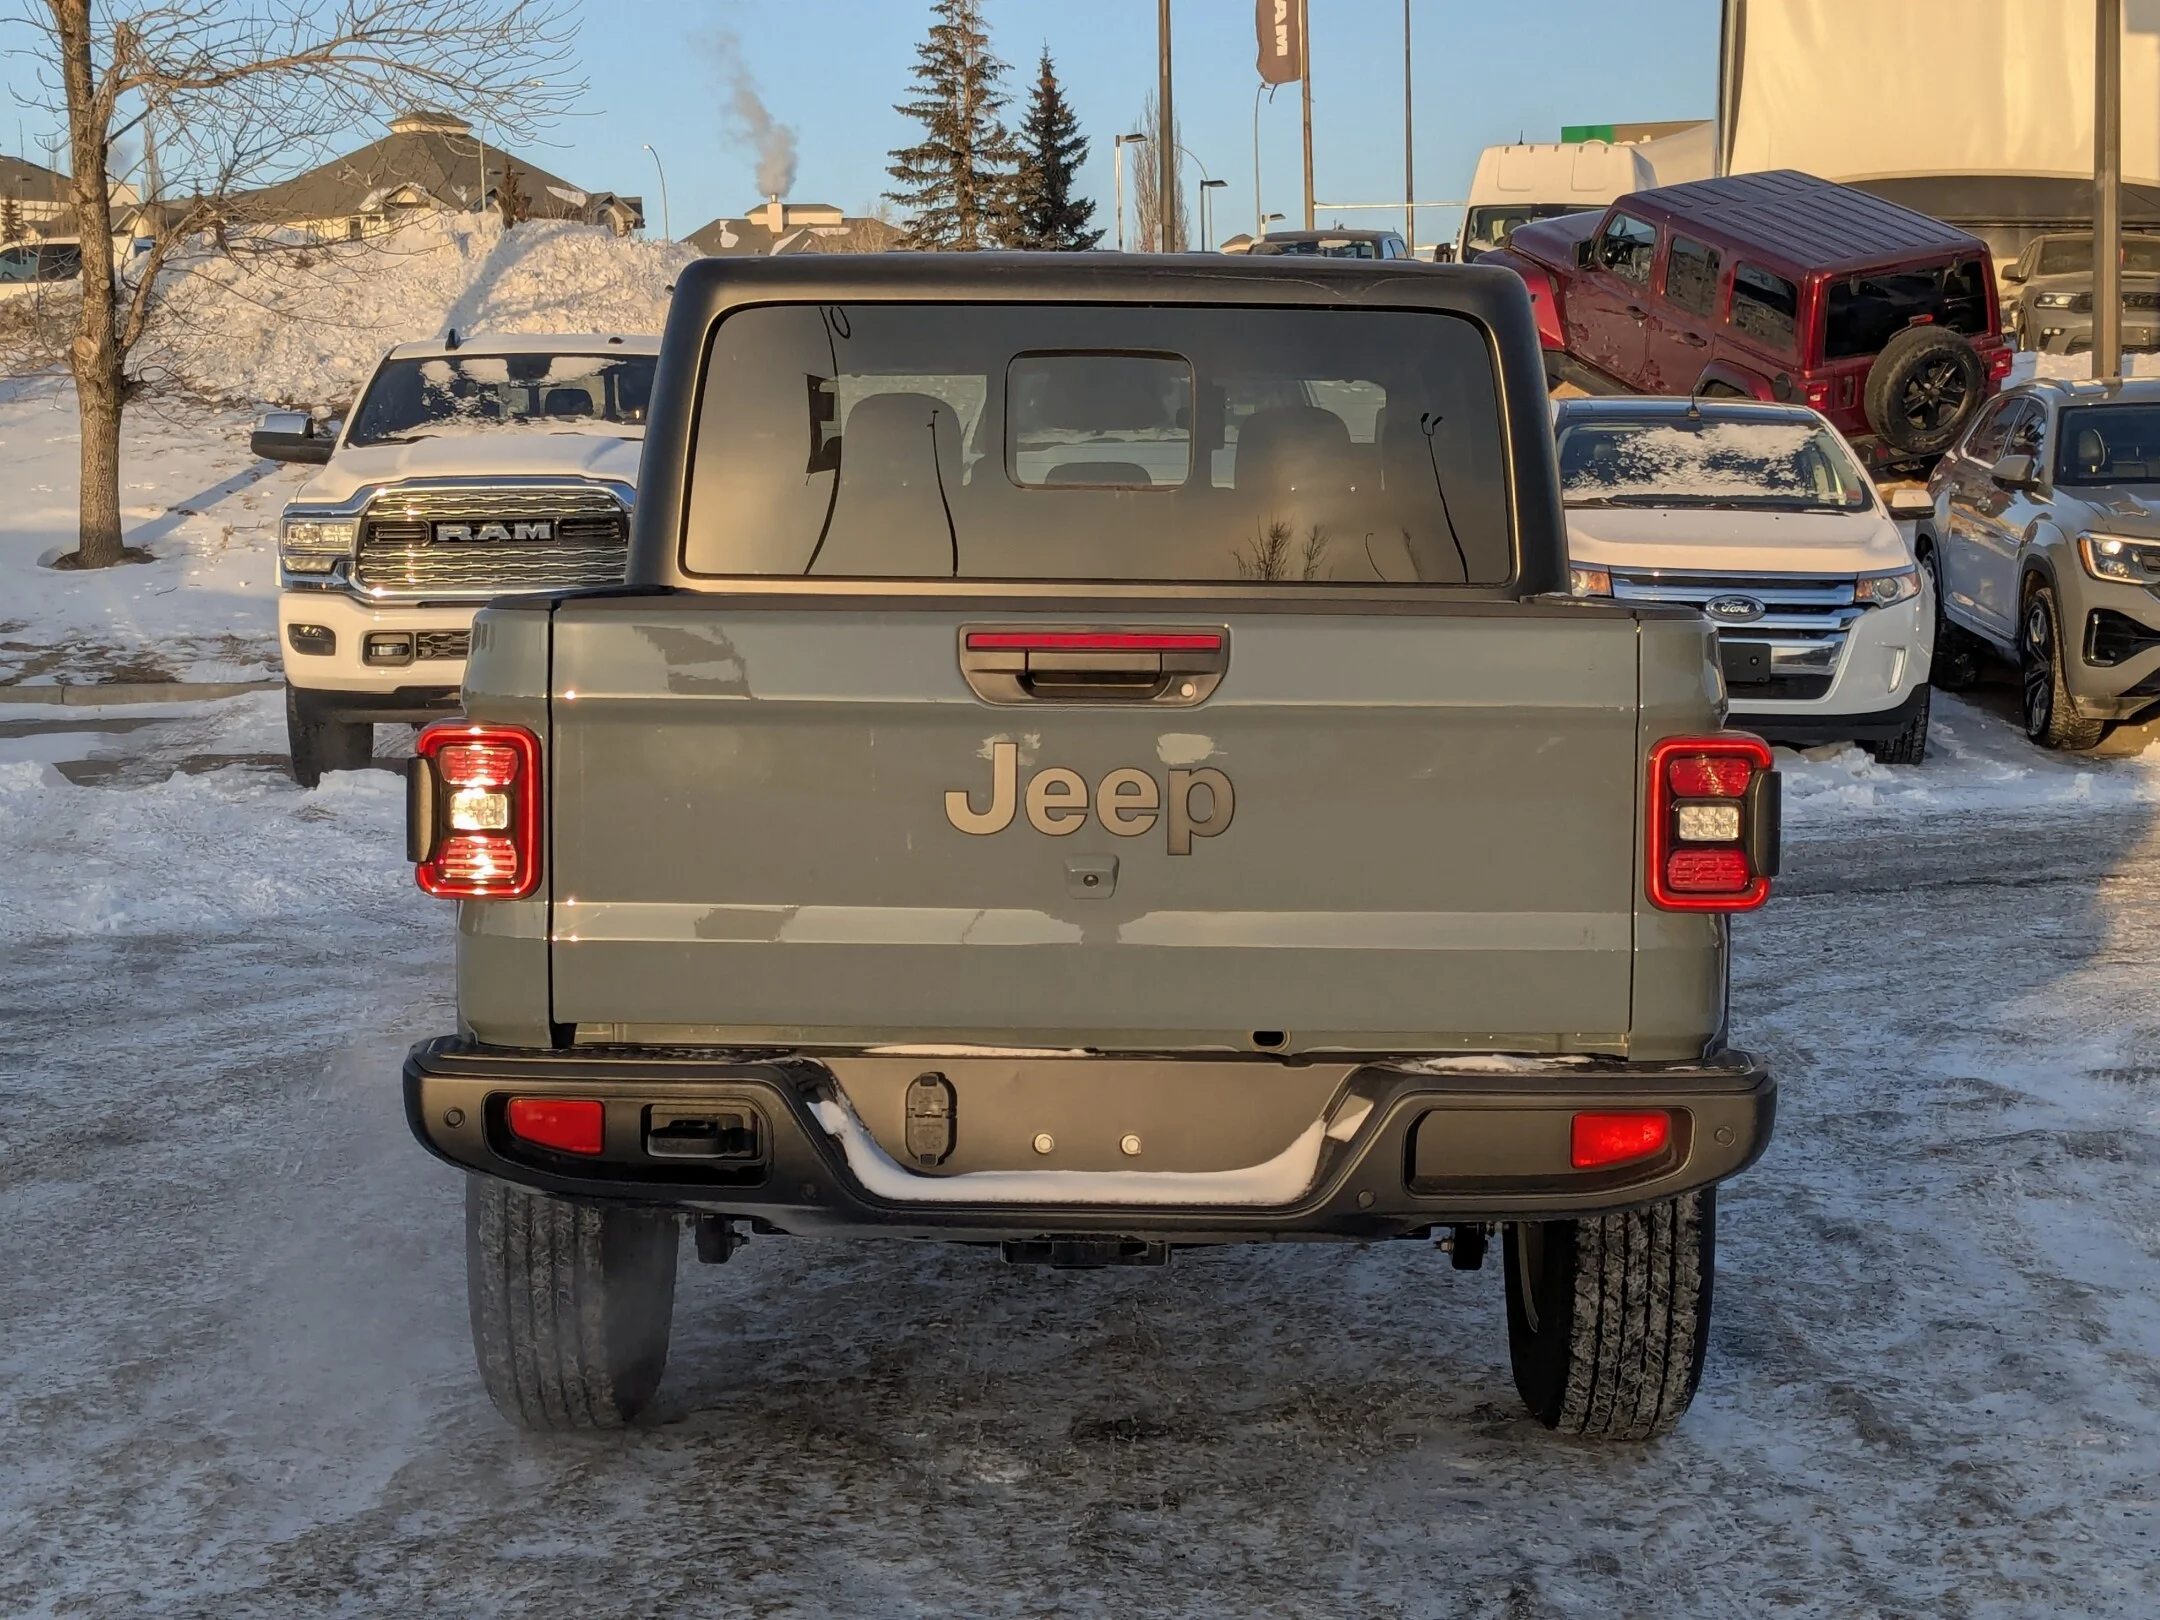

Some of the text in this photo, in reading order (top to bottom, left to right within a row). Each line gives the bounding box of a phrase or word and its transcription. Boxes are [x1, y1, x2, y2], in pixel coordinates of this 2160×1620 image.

[1274, 0, 1288, 56] AM
[437, 522, 551, 541] RAM
[1720, 600, 1751, 613] Ford
[944, 742, 1236, 855] Jeep
